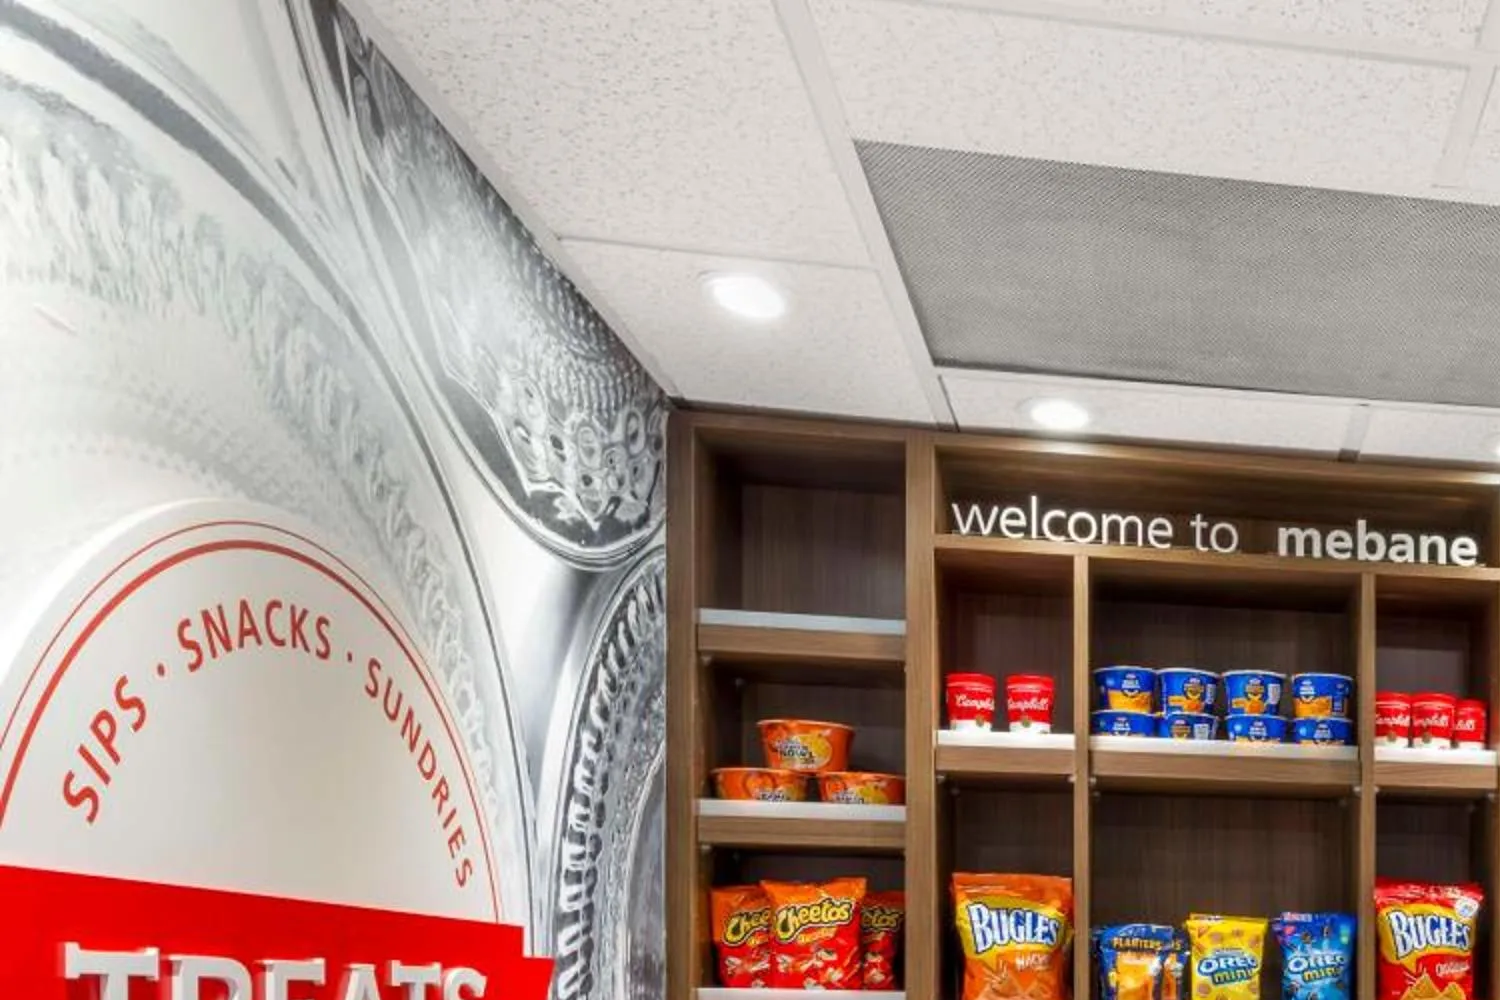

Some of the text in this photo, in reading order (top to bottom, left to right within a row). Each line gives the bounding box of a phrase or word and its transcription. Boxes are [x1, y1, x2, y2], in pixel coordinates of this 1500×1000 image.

[951, 495, 1480, 568] welcome to mebane
[62, 598, 474, 890] SIPS SNACKS SUNDRIES
[774, 897, 853, 943] Cheetos
[967, 901, 1060, 955] BUGLES
[1387, 909, 1472, 960] BUGLES
